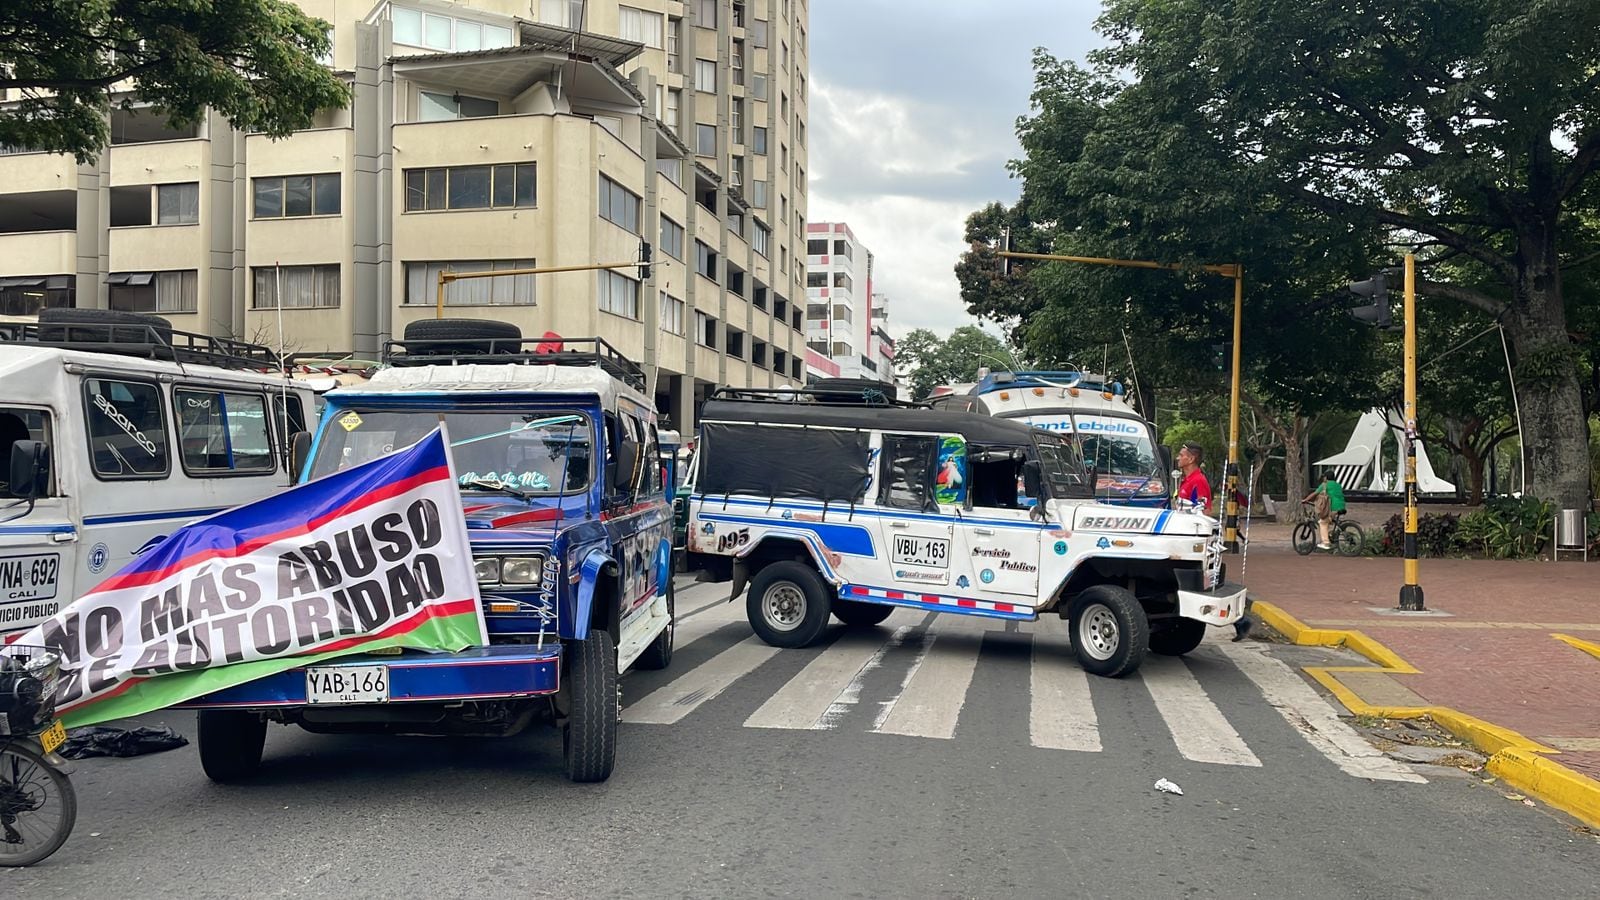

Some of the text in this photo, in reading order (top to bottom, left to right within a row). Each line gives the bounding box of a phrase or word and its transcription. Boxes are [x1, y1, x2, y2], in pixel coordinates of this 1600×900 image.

[96, 393, 156, 453] sparco
[1081, 517, 1152, 530] BELYINI
[897, 538, 946, 559] VBU 163
[972, 546, 1011, 559] Servicio
[1056, 543, 1067, 551] 31
[903, 557, 937, 565] CALI
[1000, 560, 1037, 573] Publico
[31, 558, 57, 586] 692
[41, 499, 442, 663] NO MÁS ABUSO
[8, 590, 37, 599] CALI
[23, 602, 59, 619] PUBLICO
